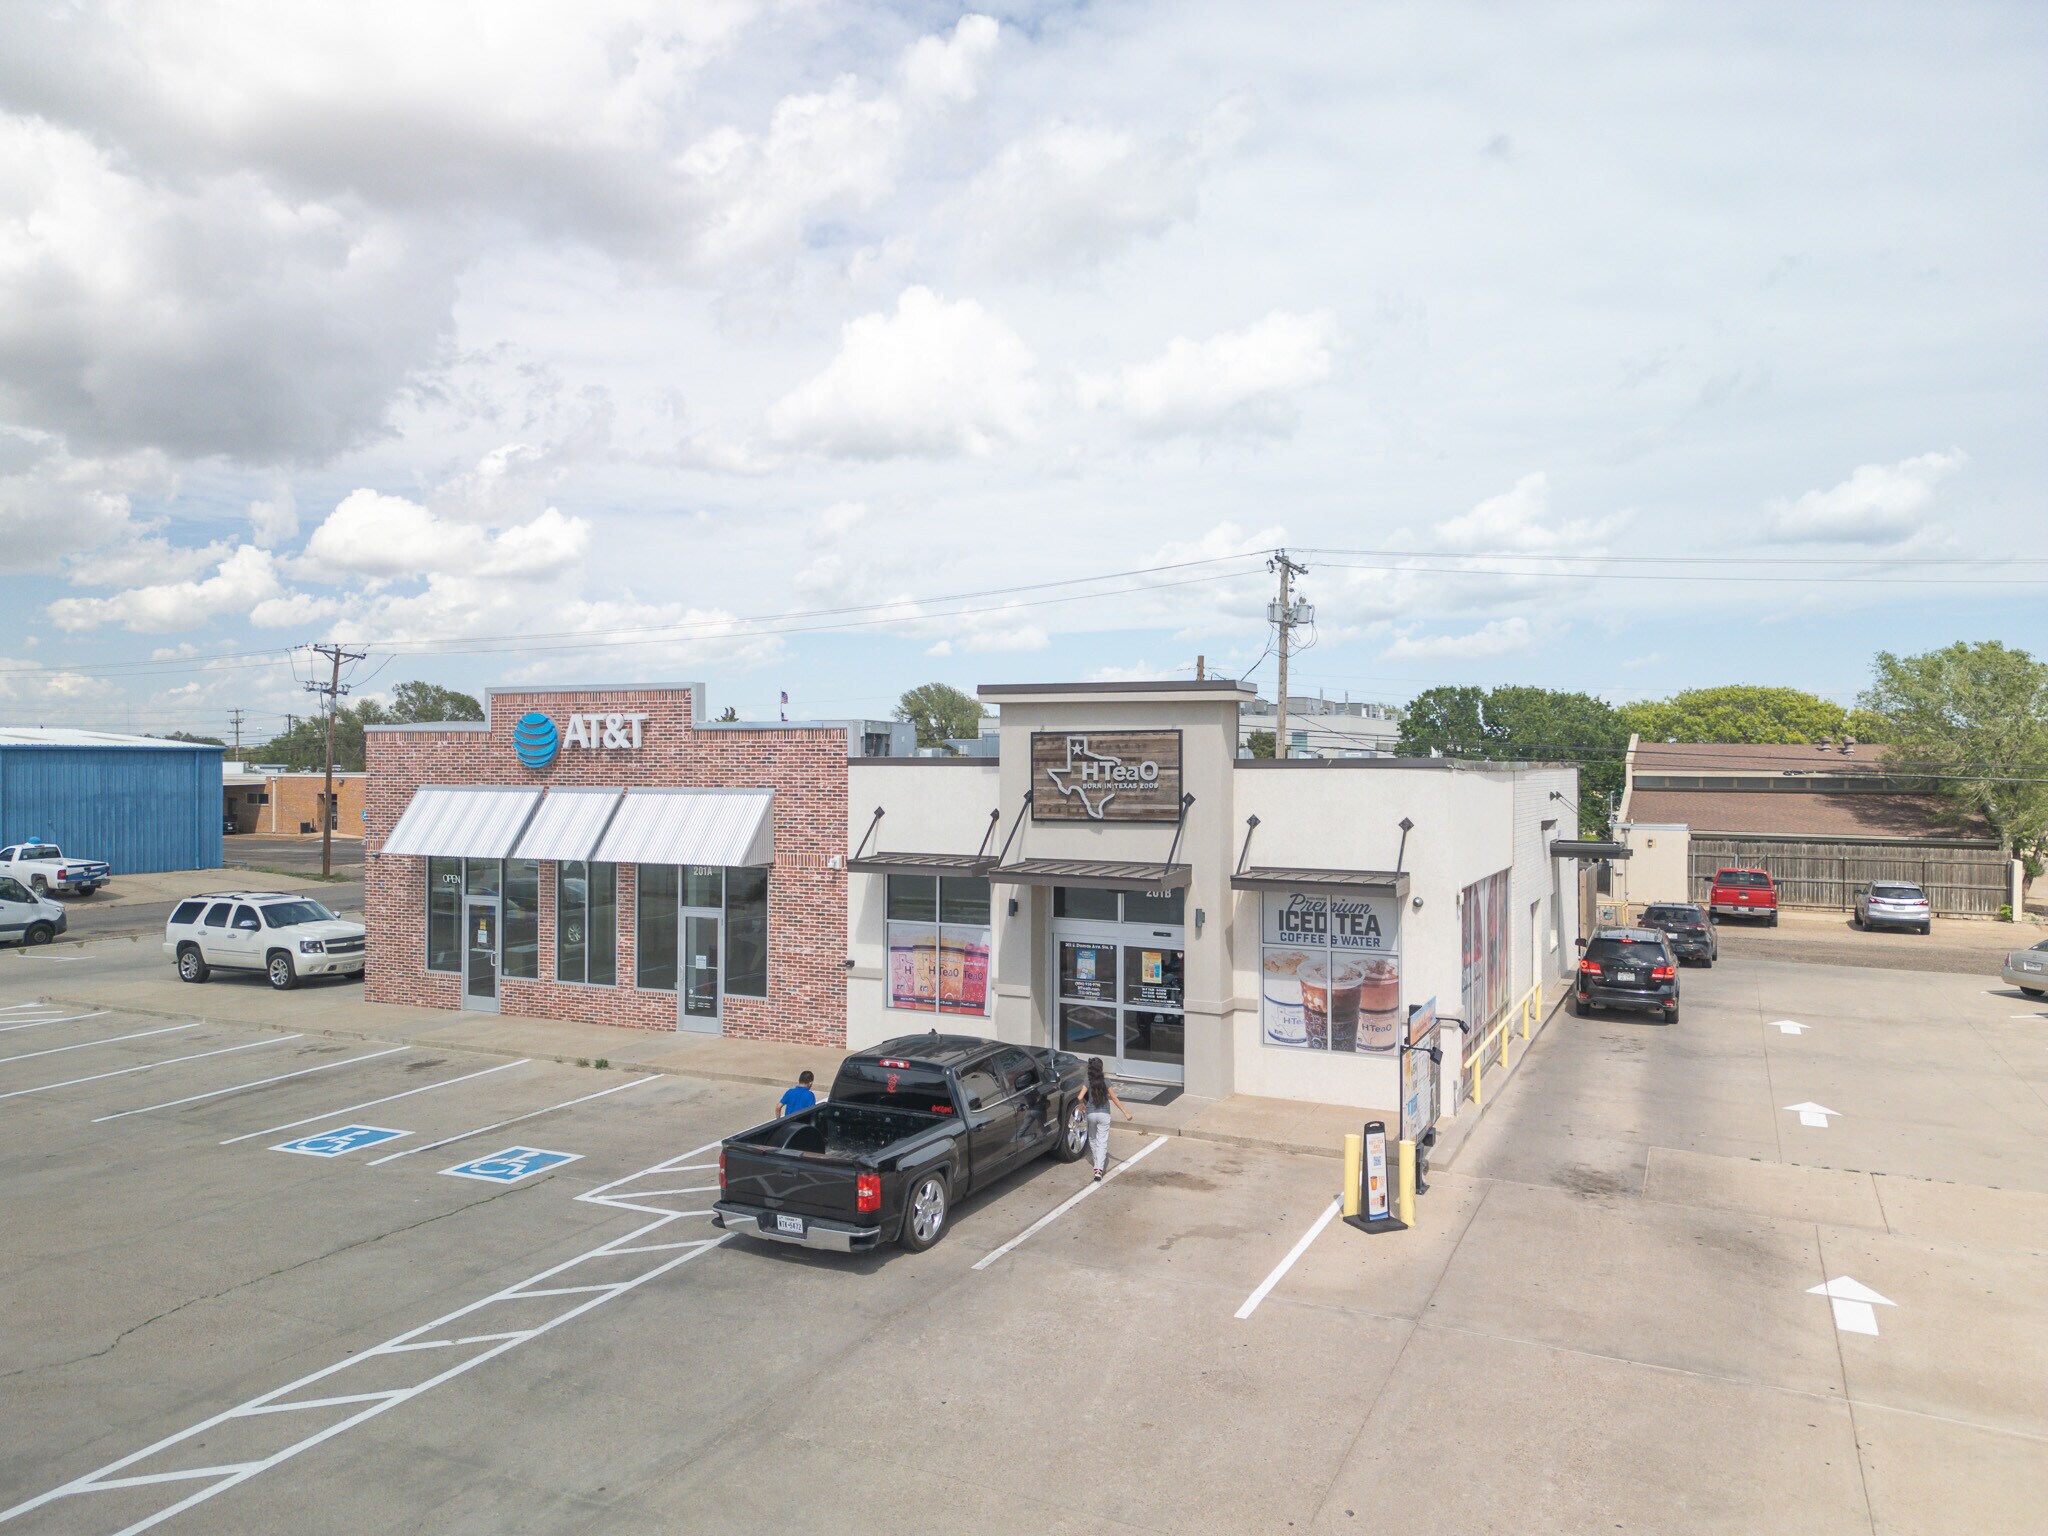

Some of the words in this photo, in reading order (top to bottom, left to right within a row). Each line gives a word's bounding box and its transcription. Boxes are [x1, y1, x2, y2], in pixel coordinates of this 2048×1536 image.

[562, 713, 648, 749] AT&T
[1081, 760, 1159, 781] HTeaO
[694, 866, 713, 876] 201A
[442, 874, 460, 884] OPEN
[1287, 893, 1372, 914] Premium
[1278, 909, 1327, 933] ICED
[1335, 913, 1382, 936] TEA
[1280, 931, 1325, 944] COFFEE
[1340, 935, 1381, 947] WATER
[963, 970, 984, 980] TeaO
[1283, 1017, 1304, 1026] HTe
[1361, 1023, 1392, 1033] HTeaO
